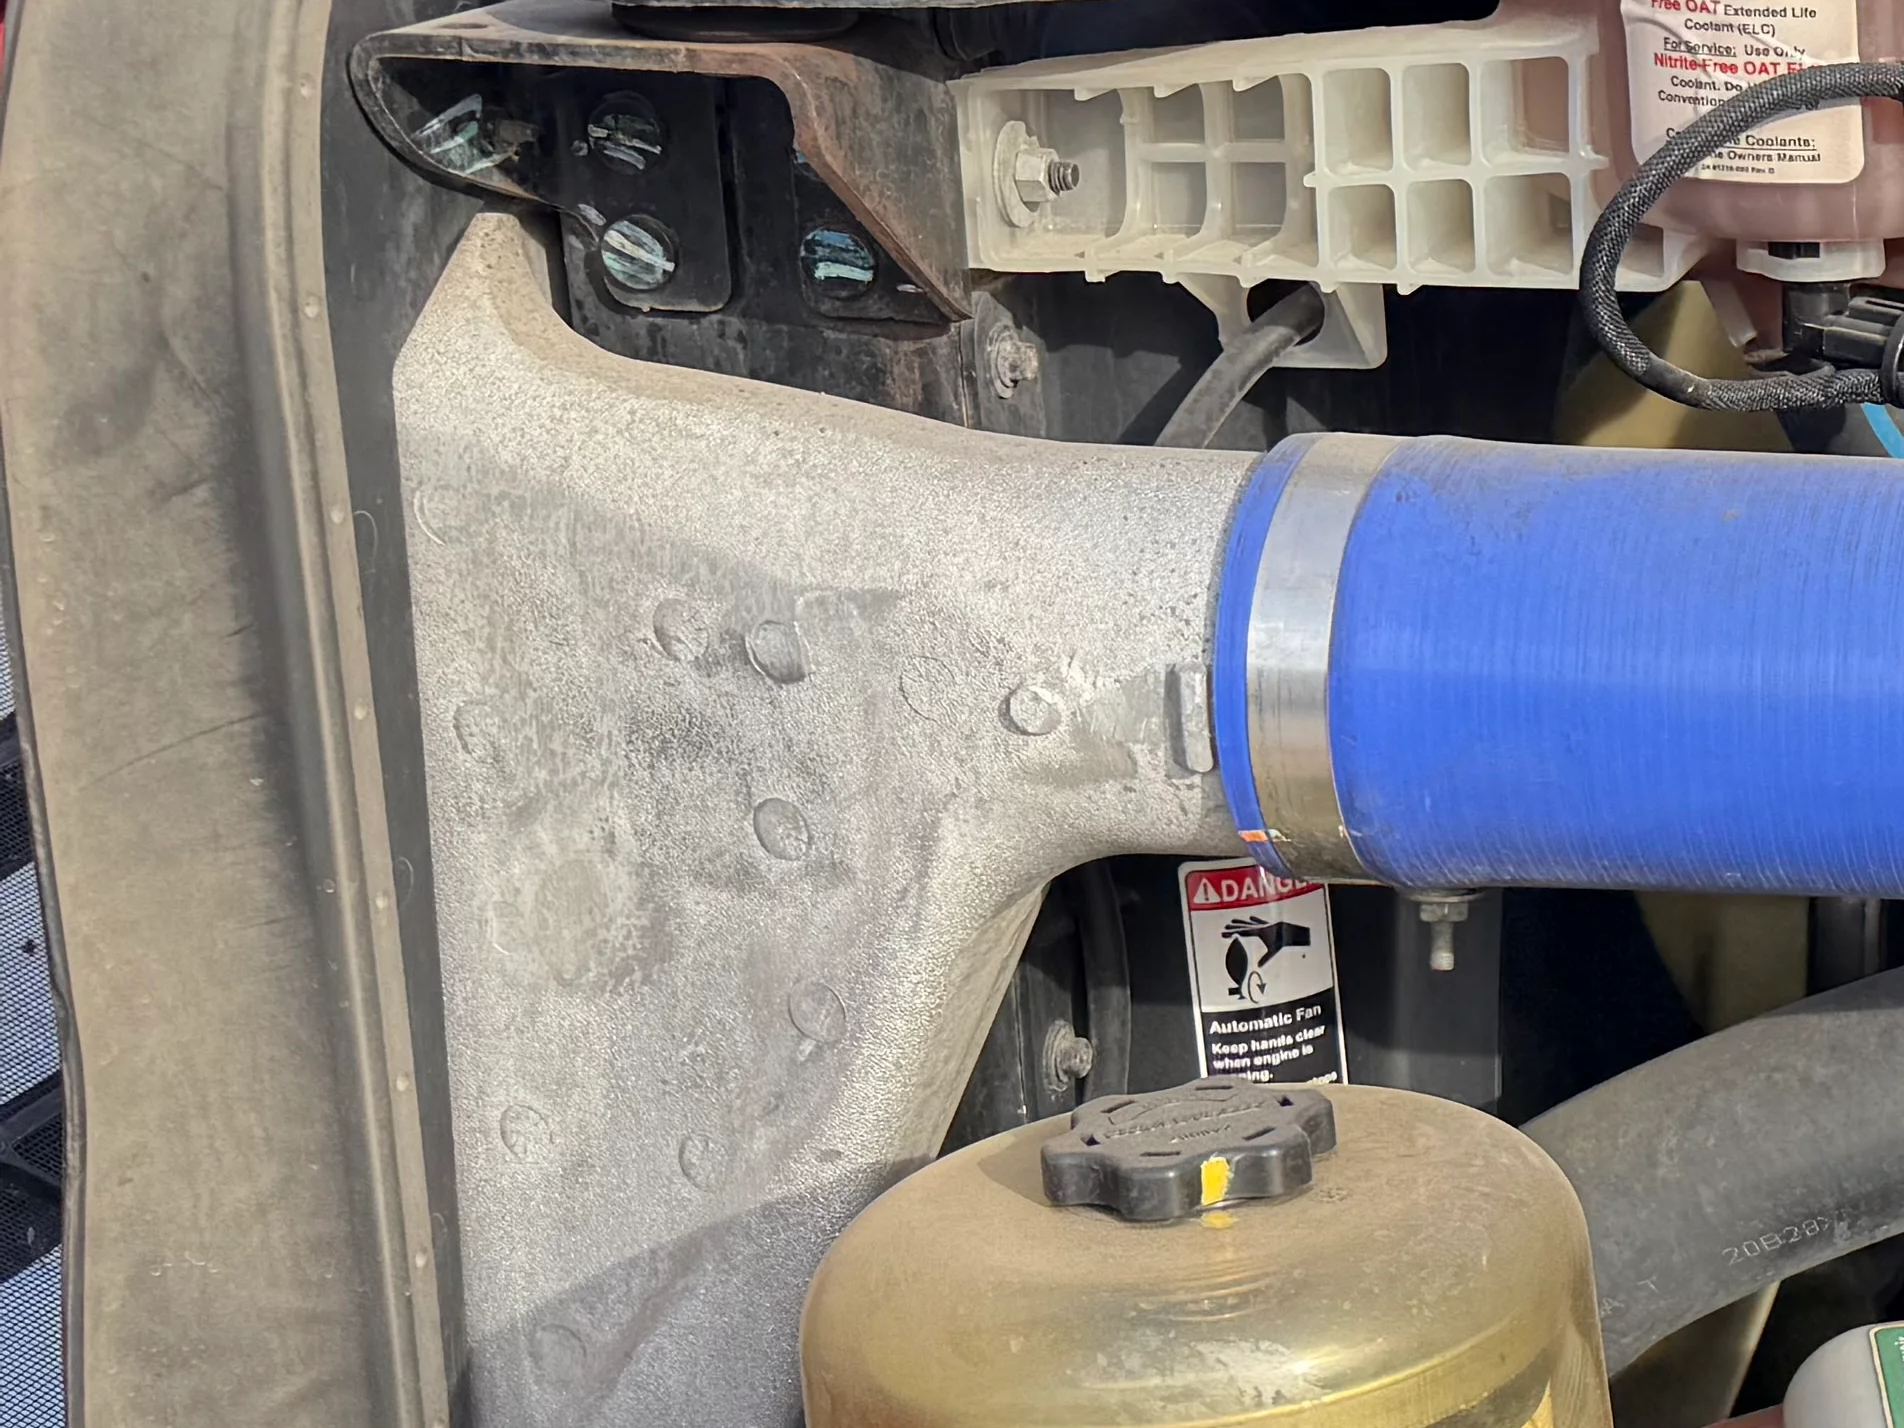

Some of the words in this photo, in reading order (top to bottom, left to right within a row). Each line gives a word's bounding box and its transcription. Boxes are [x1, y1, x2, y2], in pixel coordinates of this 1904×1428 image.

[1724, 4, 1788, 18] Extended
[1791, 8, 1817, 19] Life
[1684, 18, 1734, 33] Coolant
[1737, 22, 1776, 37] (ELC)
[1663, 37, 1682, 52] For
[1744, 44, 1770, 58] Use
[1654, 52, 1739, 75] Nitrite-Free
[1744, 62, 1781, 76] OAT
[1724, 82, 1744, 92] Do
[1745, 134, 1816, 148] Coolants:
[1728, 150, 1773, 162] Owners
[1776, 152, 1821, 163] Manual
[1221, 878, 1314, 902] DANG
[1209, 1013, 1293, 1035] Automatic
[1296, 1004, 1322, 1021] Fan
[1212, 1040, 1248, 1055] Keep
[1251, 1034, 1294, 1051] hands
[1296, 1025, 1326, 1041] clear
[1212, 1055, 1251, 1069] when
[1253, 1051, 1300, 1066] engine
[1302, 1044, 1314, 1057] is
